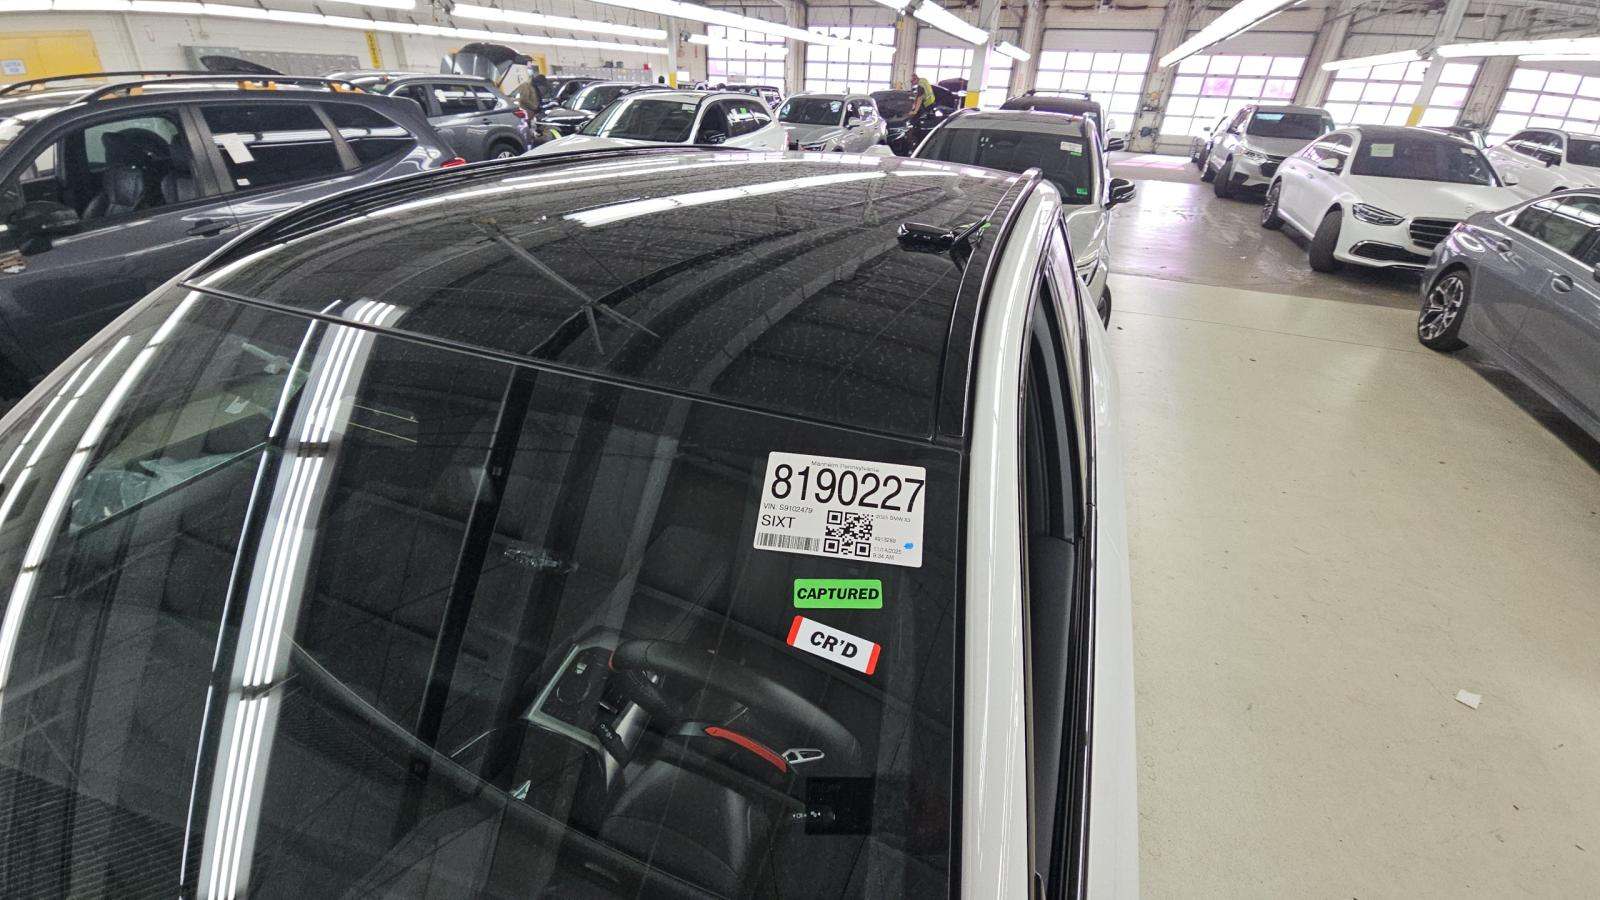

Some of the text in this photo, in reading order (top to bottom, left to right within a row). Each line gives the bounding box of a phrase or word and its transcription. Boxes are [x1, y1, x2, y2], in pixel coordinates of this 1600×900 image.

[771, 463, 925, 513] 8190227
[761, 514, 797, 529] SIXT
[797, 587, 880, 600] CAPTURED
[810, 631, 858, 659] CR'D
